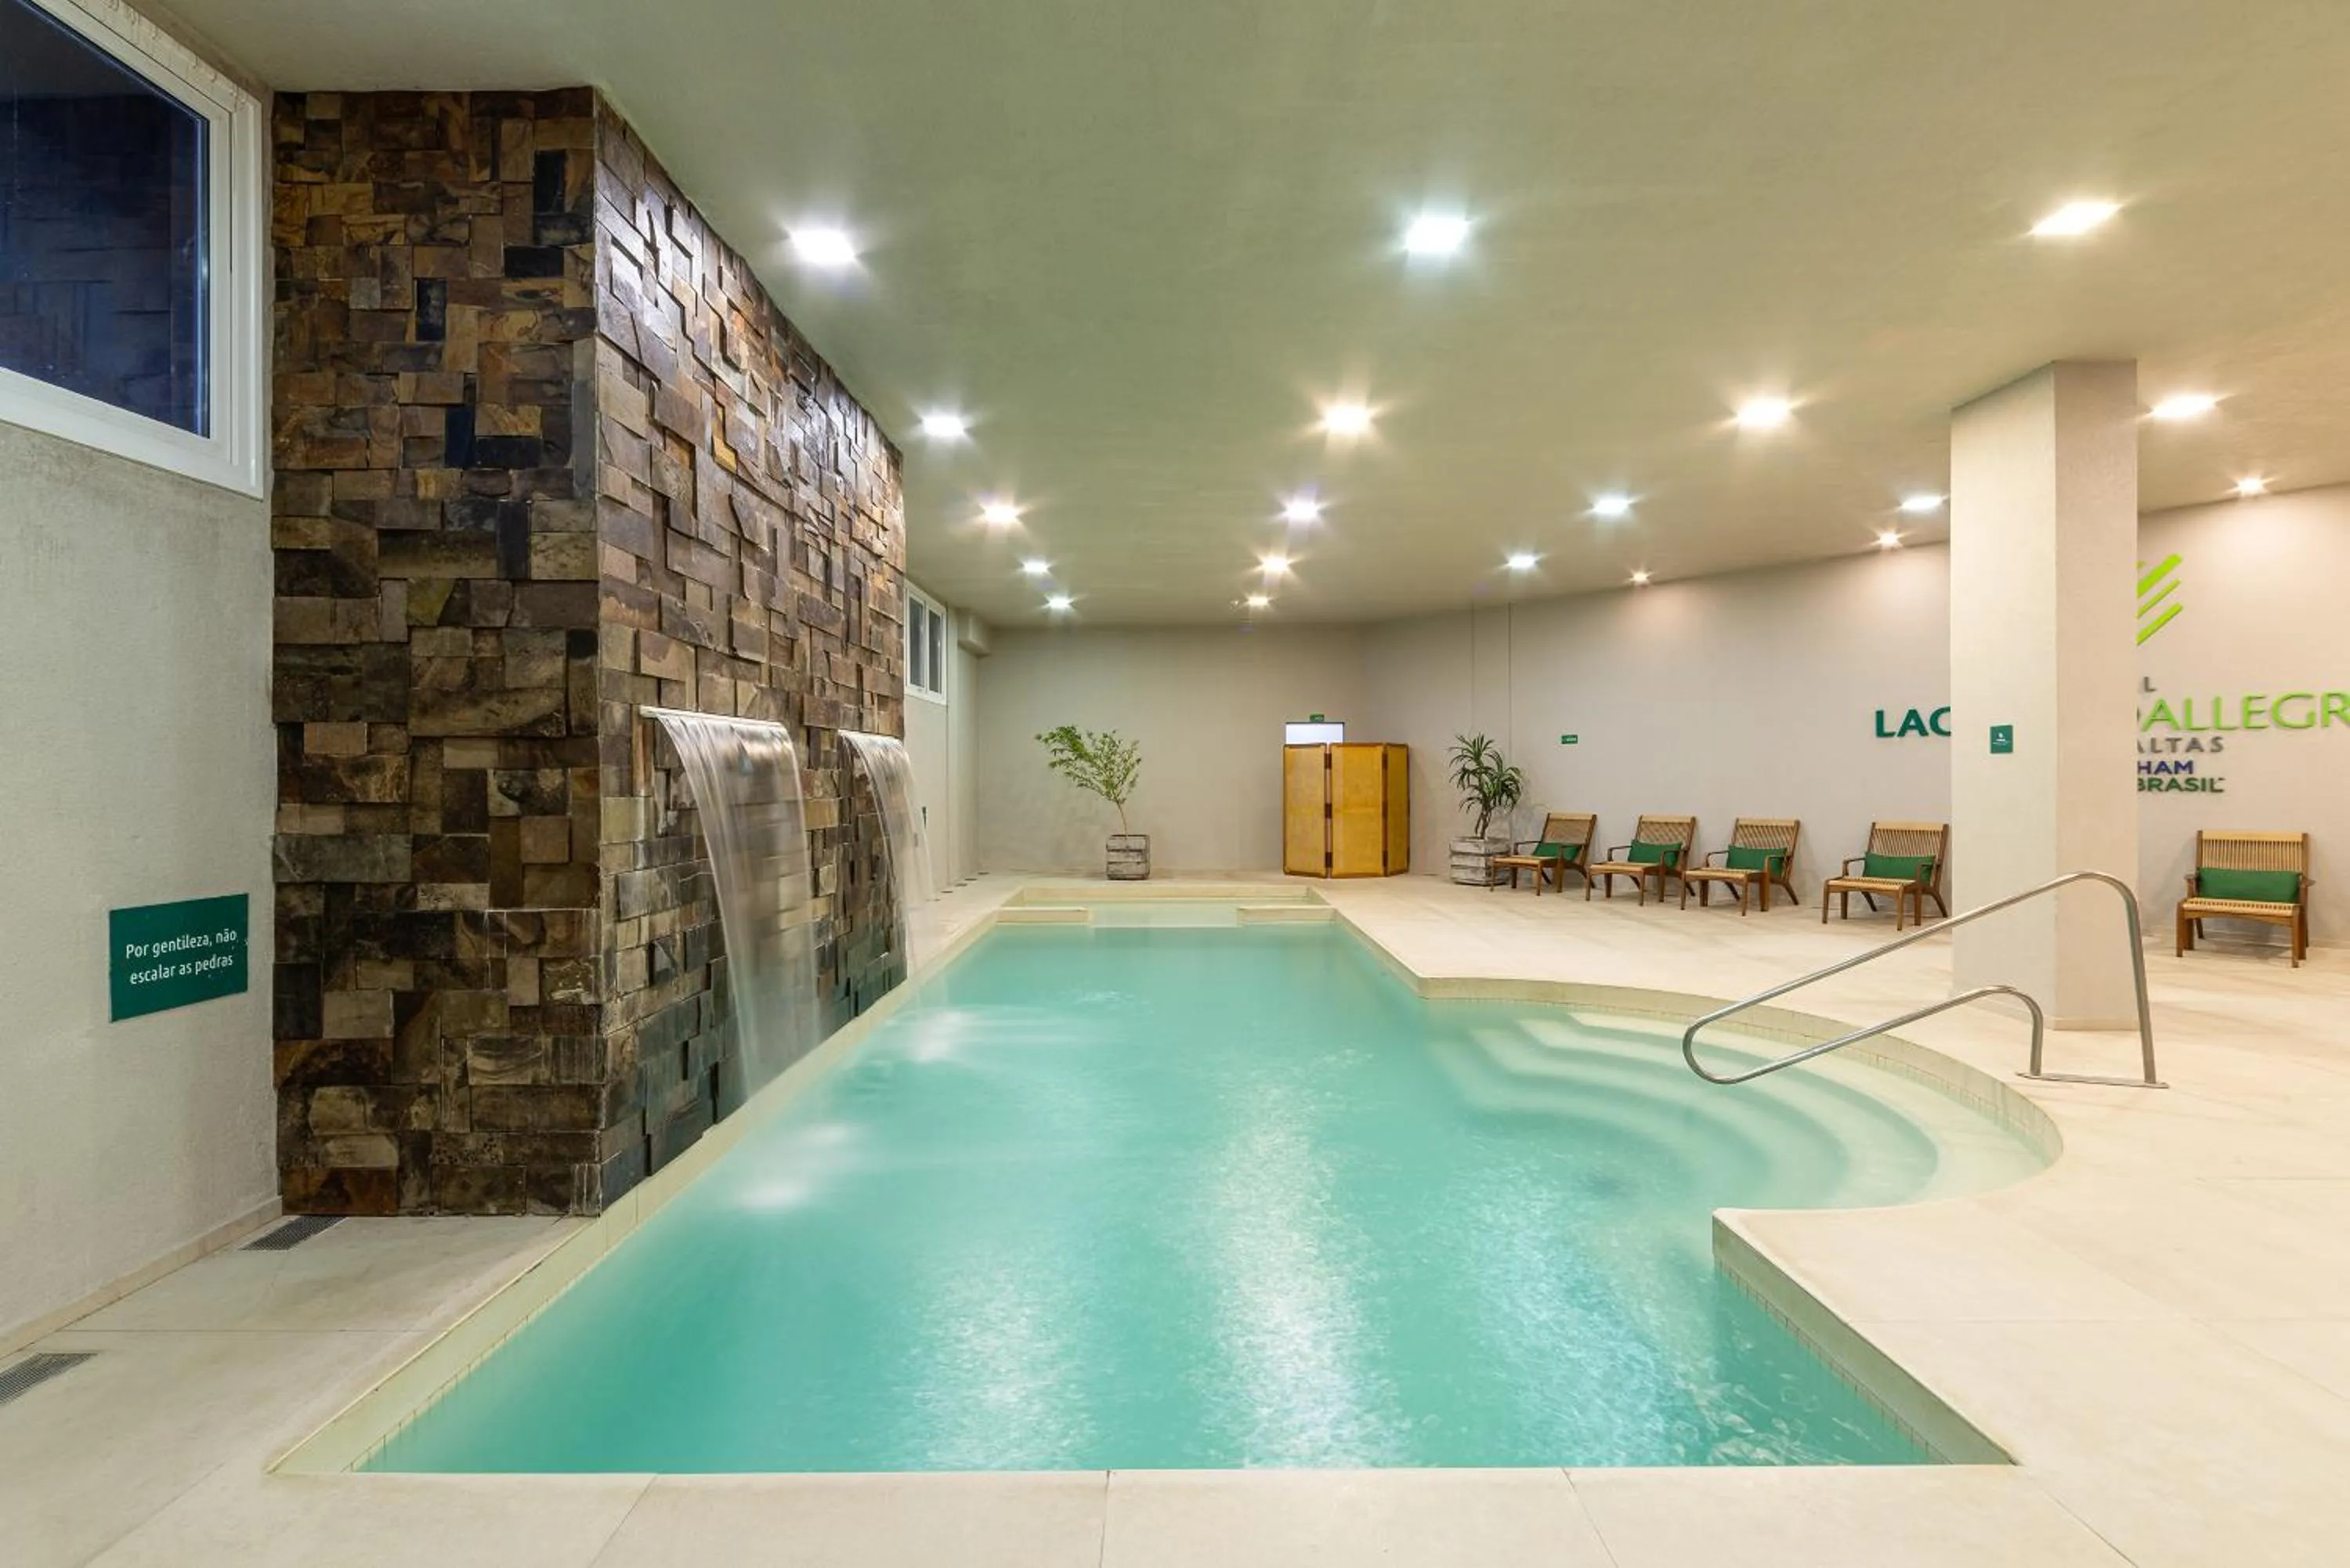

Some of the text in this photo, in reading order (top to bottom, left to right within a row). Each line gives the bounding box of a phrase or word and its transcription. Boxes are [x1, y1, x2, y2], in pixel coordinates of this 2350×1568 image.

[2137, 760, 2194, 775] HAM
[126, 928, 237, 959] Por gentileza, não
[129, 954, 233, 985] escalar as pedras
